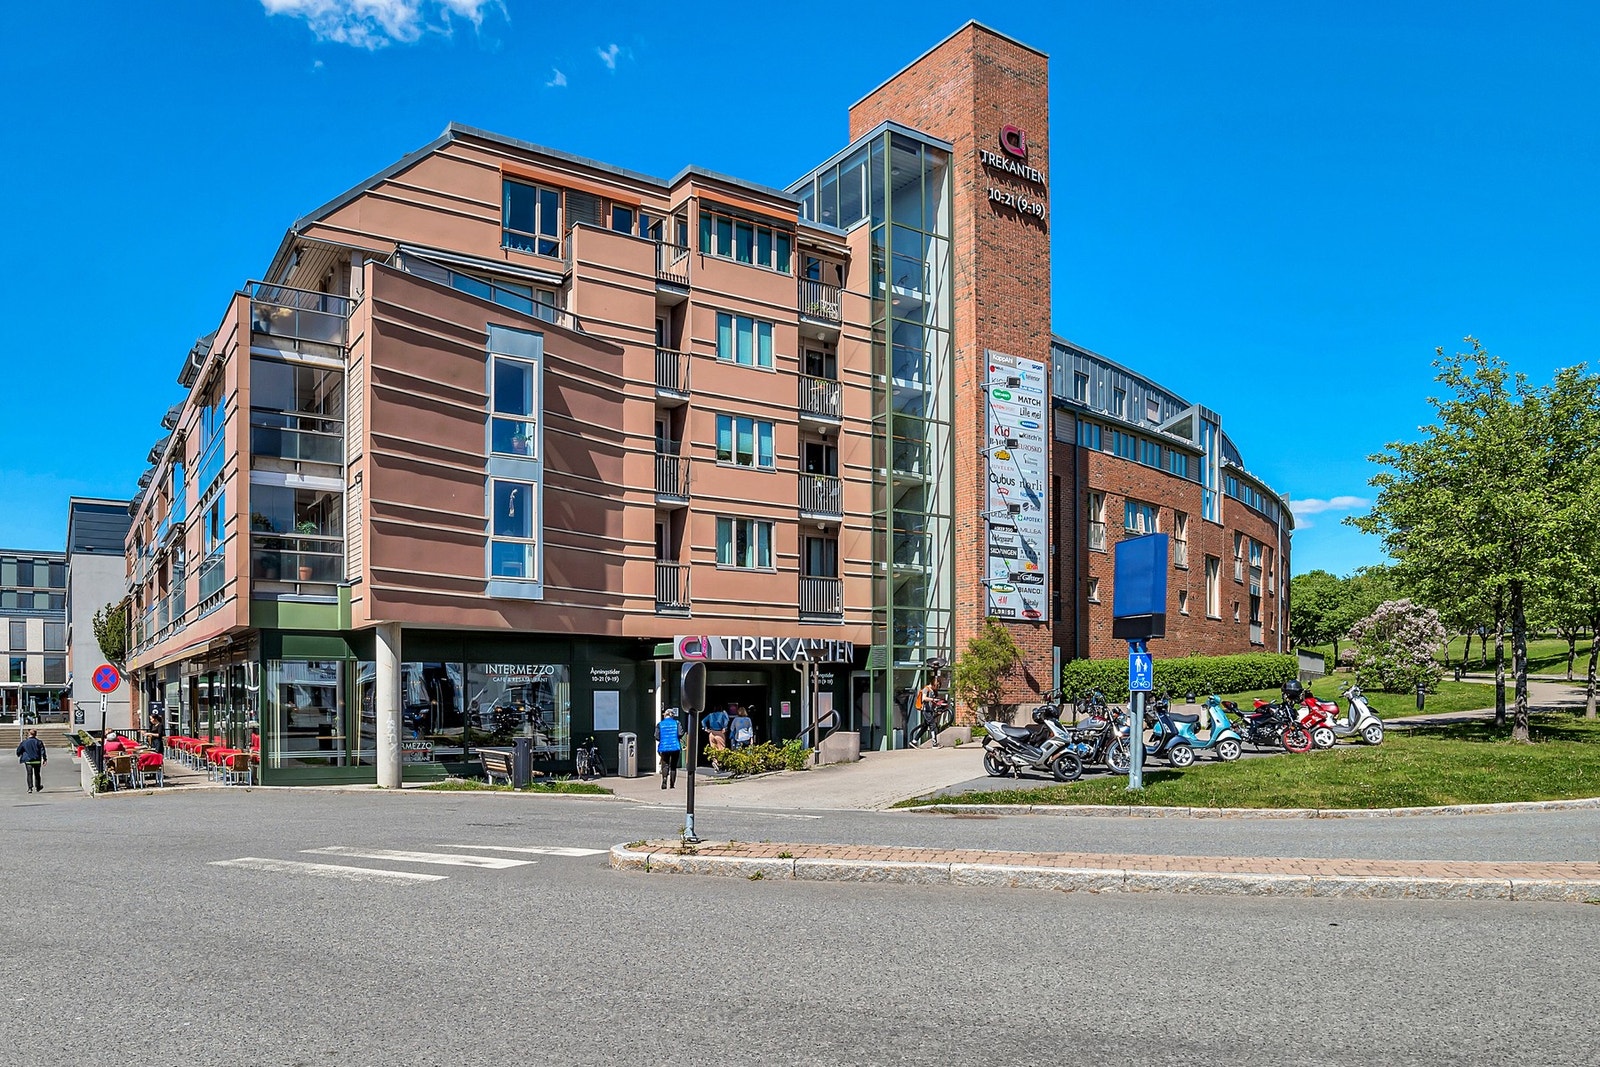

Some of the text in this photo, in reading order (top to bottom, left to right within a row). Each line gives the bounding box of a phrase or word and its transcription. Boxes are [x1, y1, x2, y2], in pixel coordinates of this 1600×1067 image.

[981, 149, 1046, 184] TREKANTEN
[989, 188, 1046, 220] 10-21 (9-19)
[1018, 395, 1042, 407] MATCH
[994, 424, 1010, 438] Kid
[989, 472, 1016, 487] Cubus
[1019, 479, 1043, 491] norli
[720, 636, 854, 663] TREKANTEN
[485, 663, 555, 675] INTERMEZZO
[401, 742, 433, 750] RMEZZO
